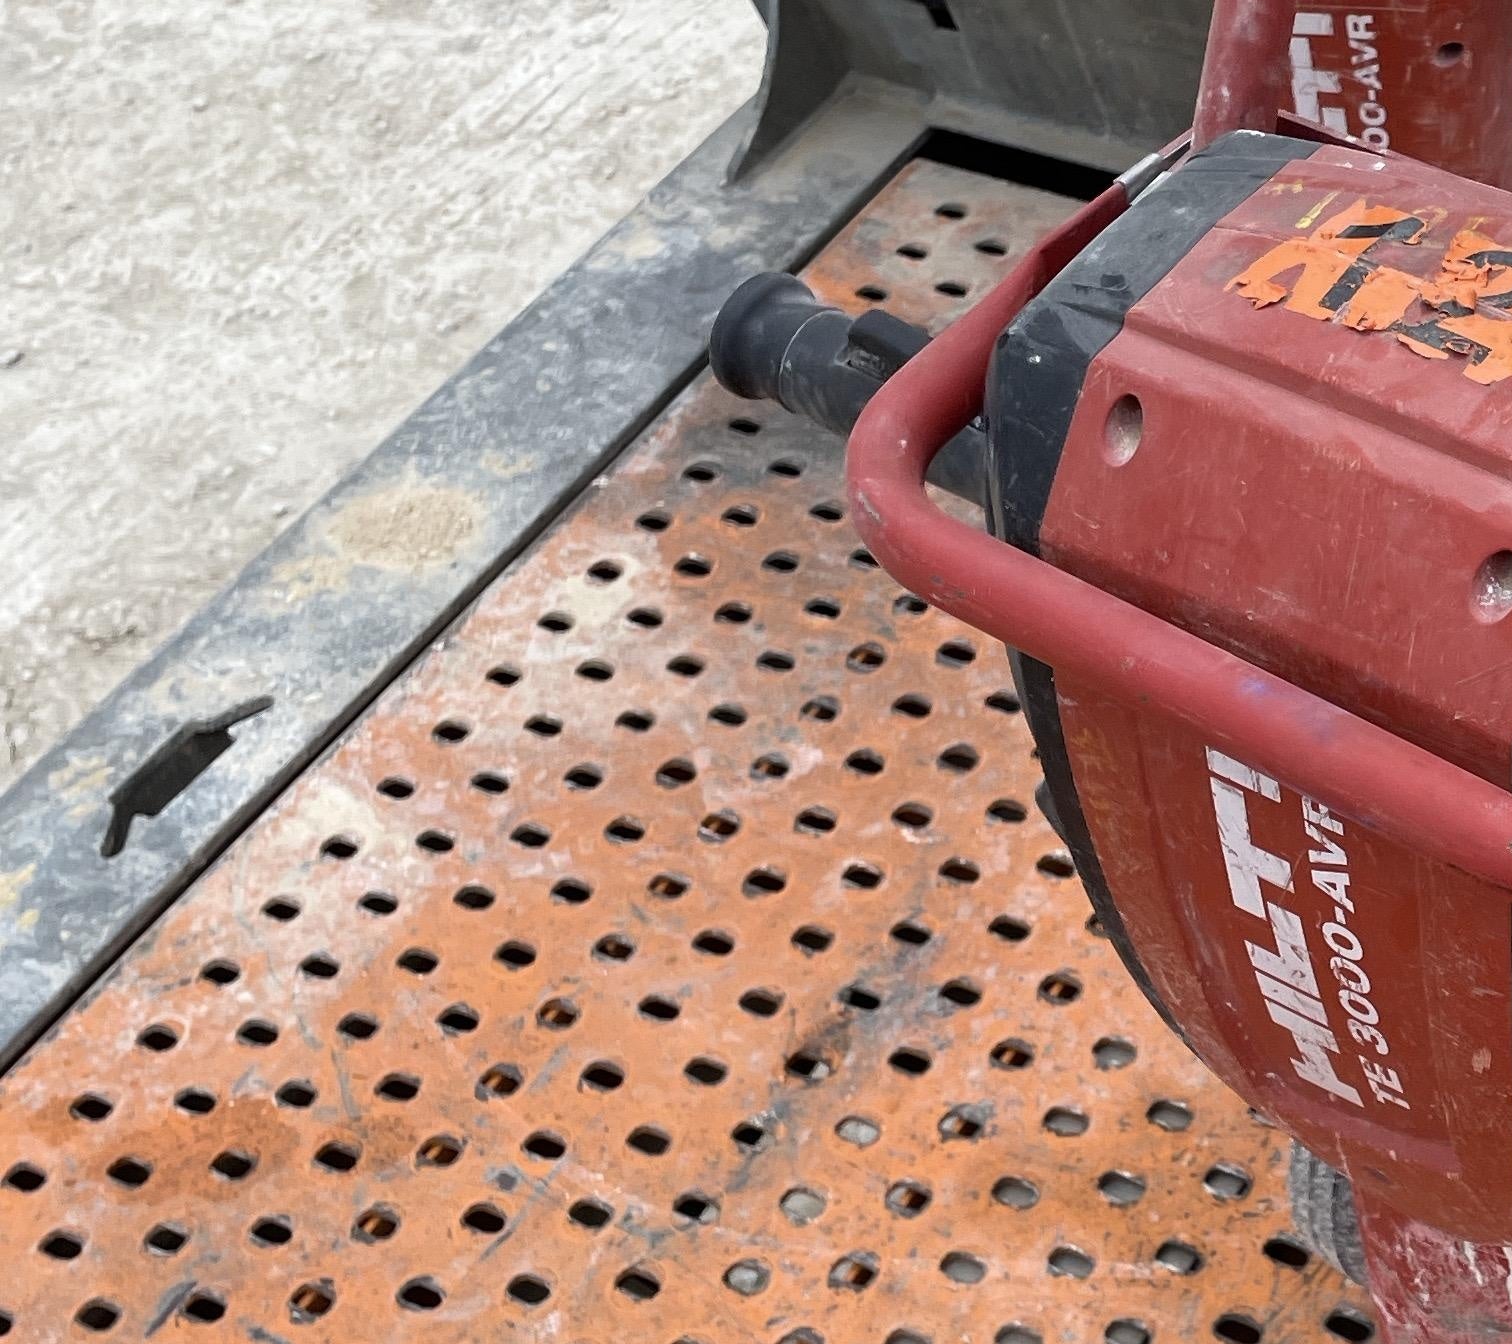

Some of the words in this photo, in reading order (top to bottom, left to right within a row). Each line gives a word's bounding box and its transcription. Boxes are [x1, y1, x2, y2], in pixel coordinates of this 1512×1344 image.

[1345, 13, 1391, 152] 00-AVR
[1205, 745, 1365, 1109] HILTI
[1358, 1054, 1411, 1110] TE
